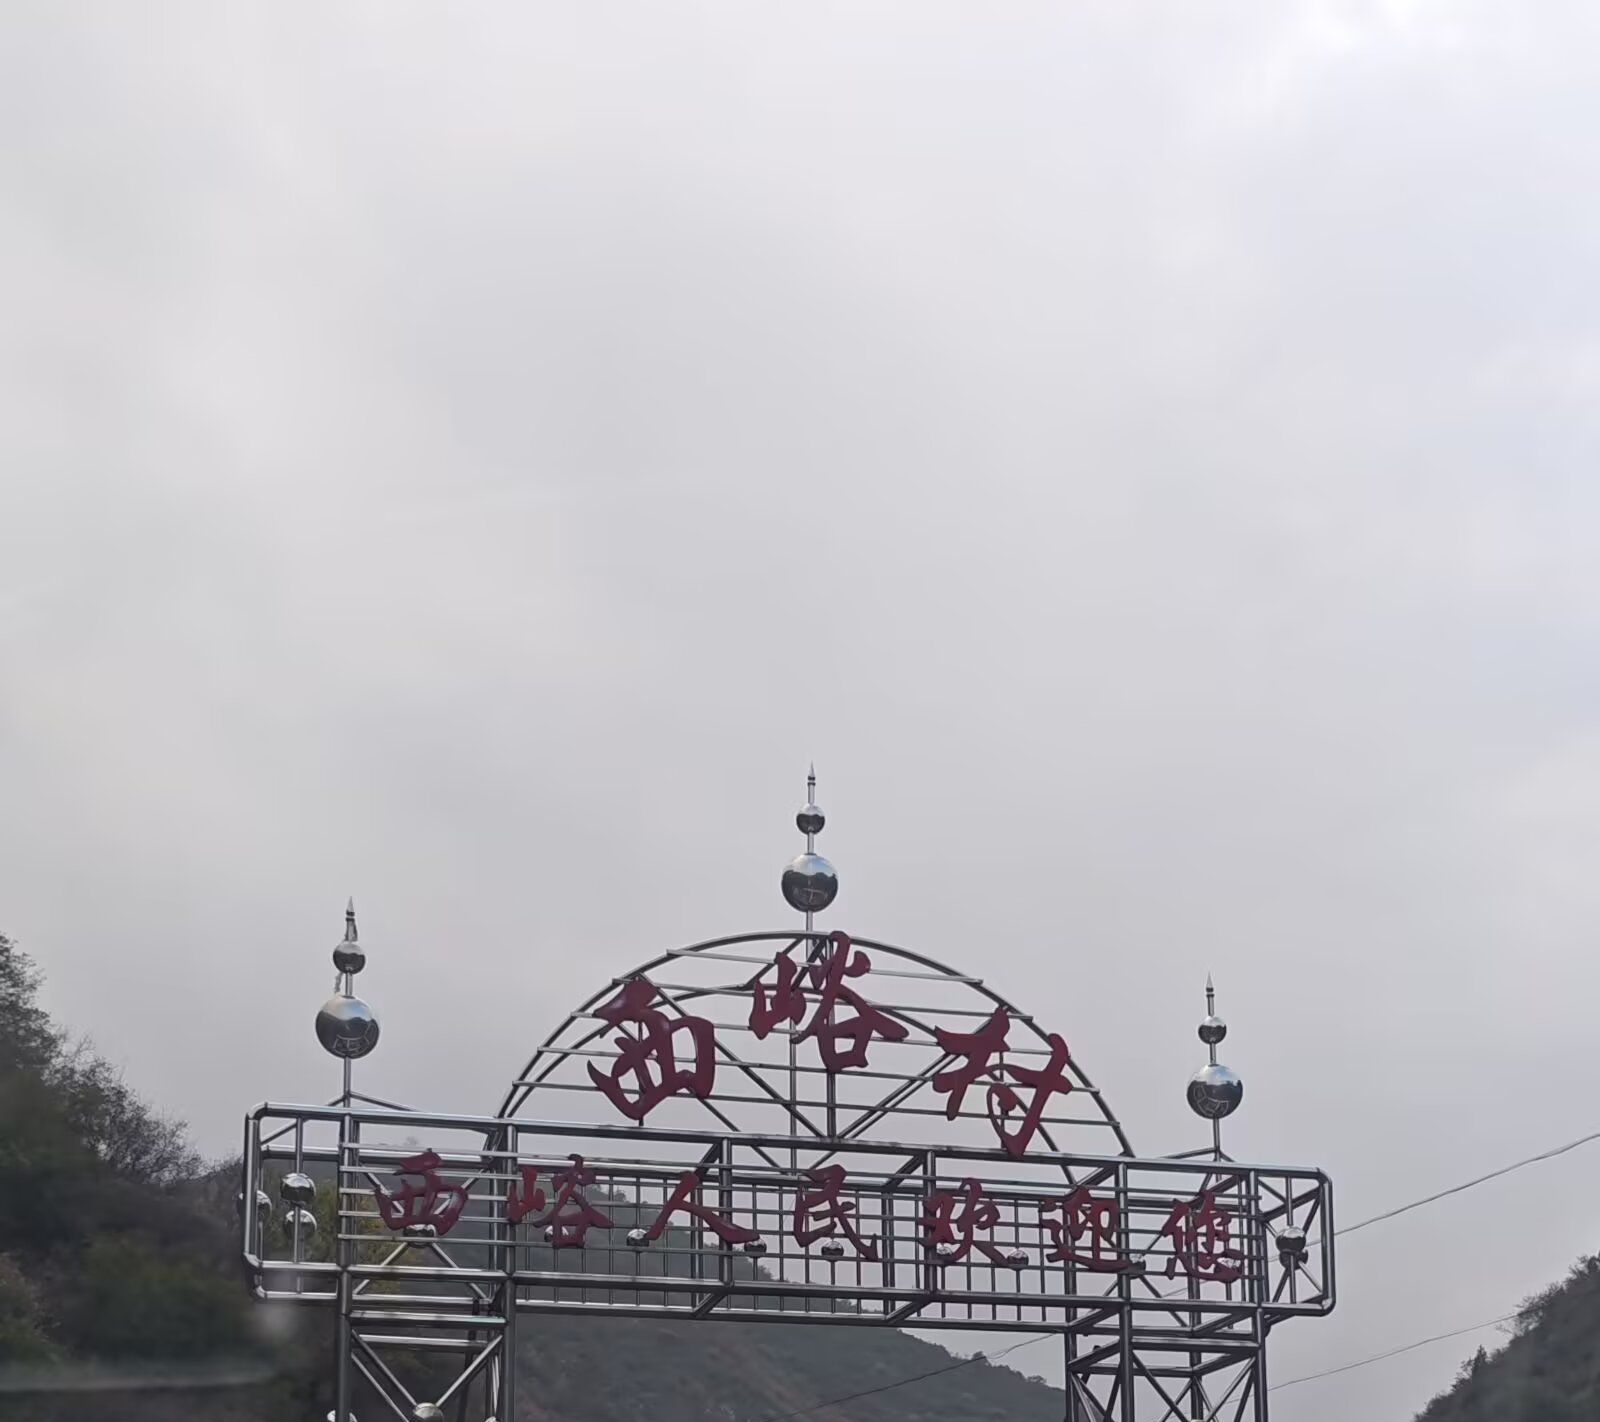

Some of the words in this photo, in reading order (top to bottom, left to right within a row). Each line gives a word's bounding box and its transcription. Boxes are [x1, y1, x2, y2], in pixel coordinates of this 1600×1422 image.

[587, 930, 1073, 1156] 西峪村
[375, 1149, 1244, 1283] 西峪人民欢迎您
